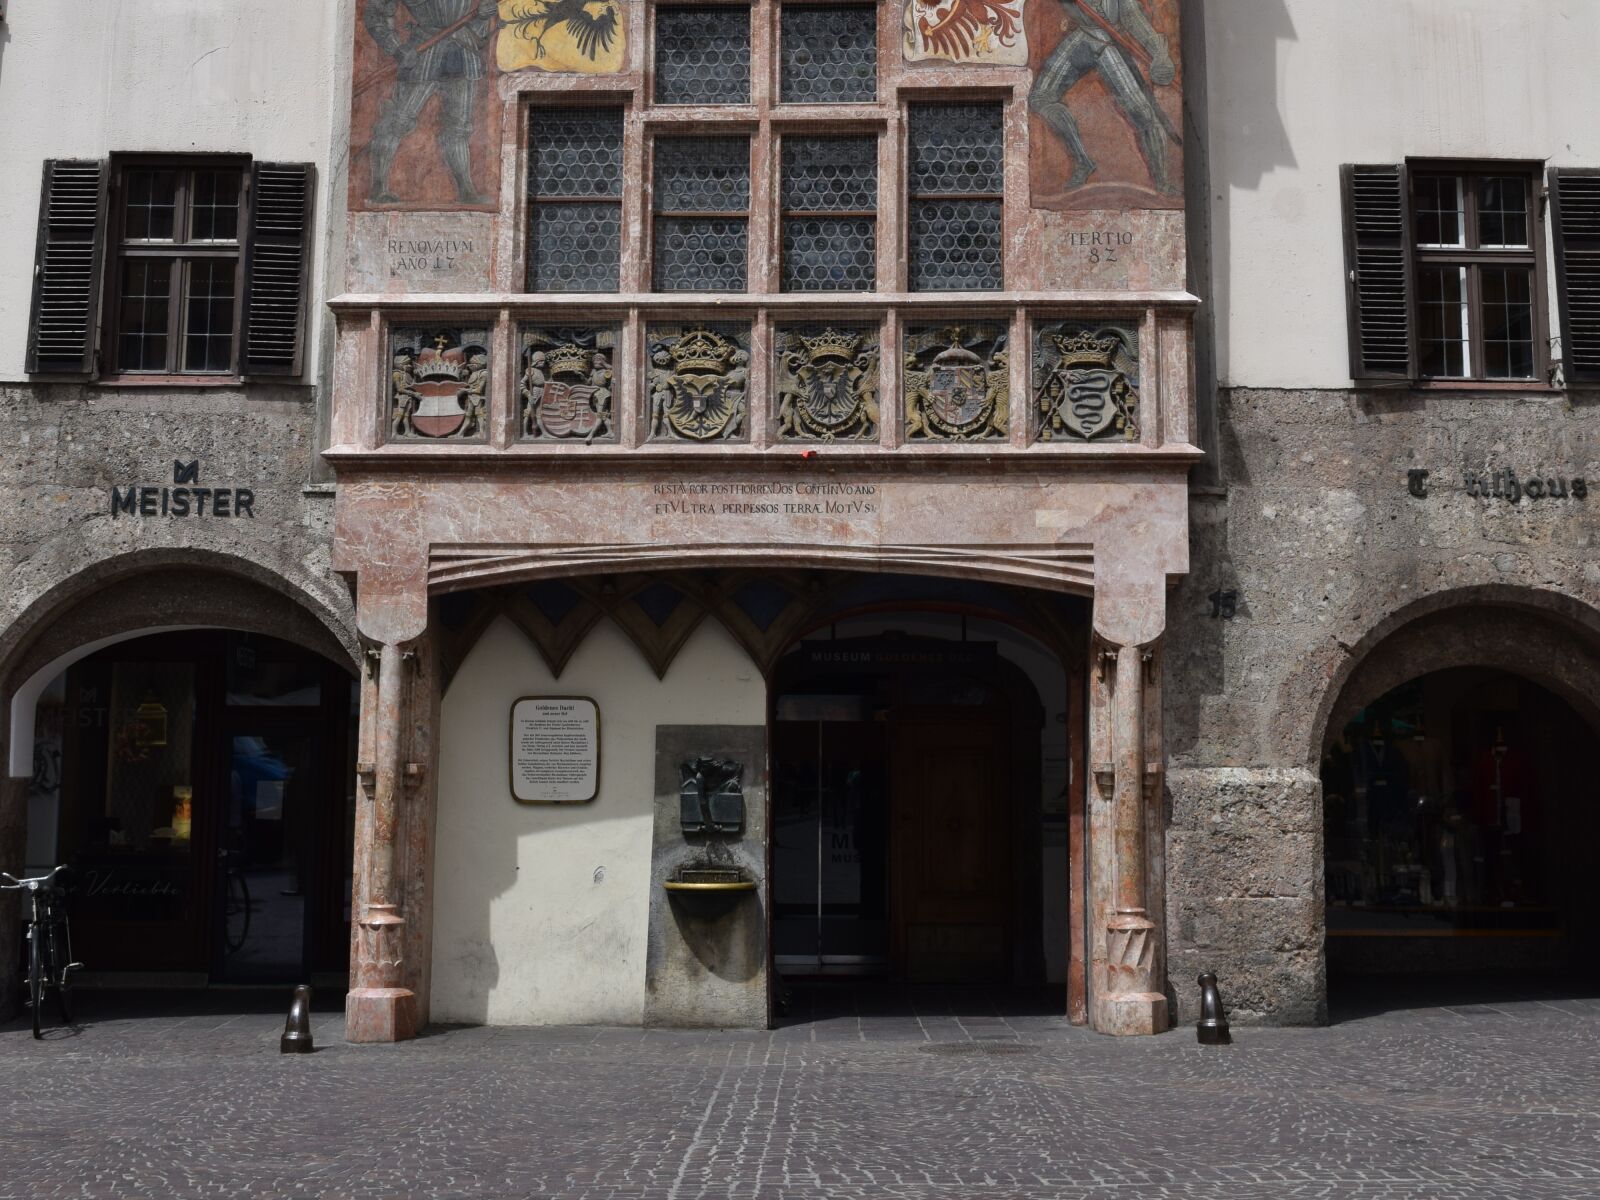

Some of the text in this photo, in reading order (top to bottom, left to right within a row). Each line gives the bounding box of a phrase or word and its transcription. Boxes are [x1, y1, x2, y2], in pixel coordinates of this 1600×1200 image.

[1067, 231, 1133, 246] TERTIO
[388, 240, 473, 254] RENOVATVM
[111, 486, 255, 518] MEISTER
[722, 503, 779, 514] PERPESSOS
[811, 652, 871, 663] MUSEUM
